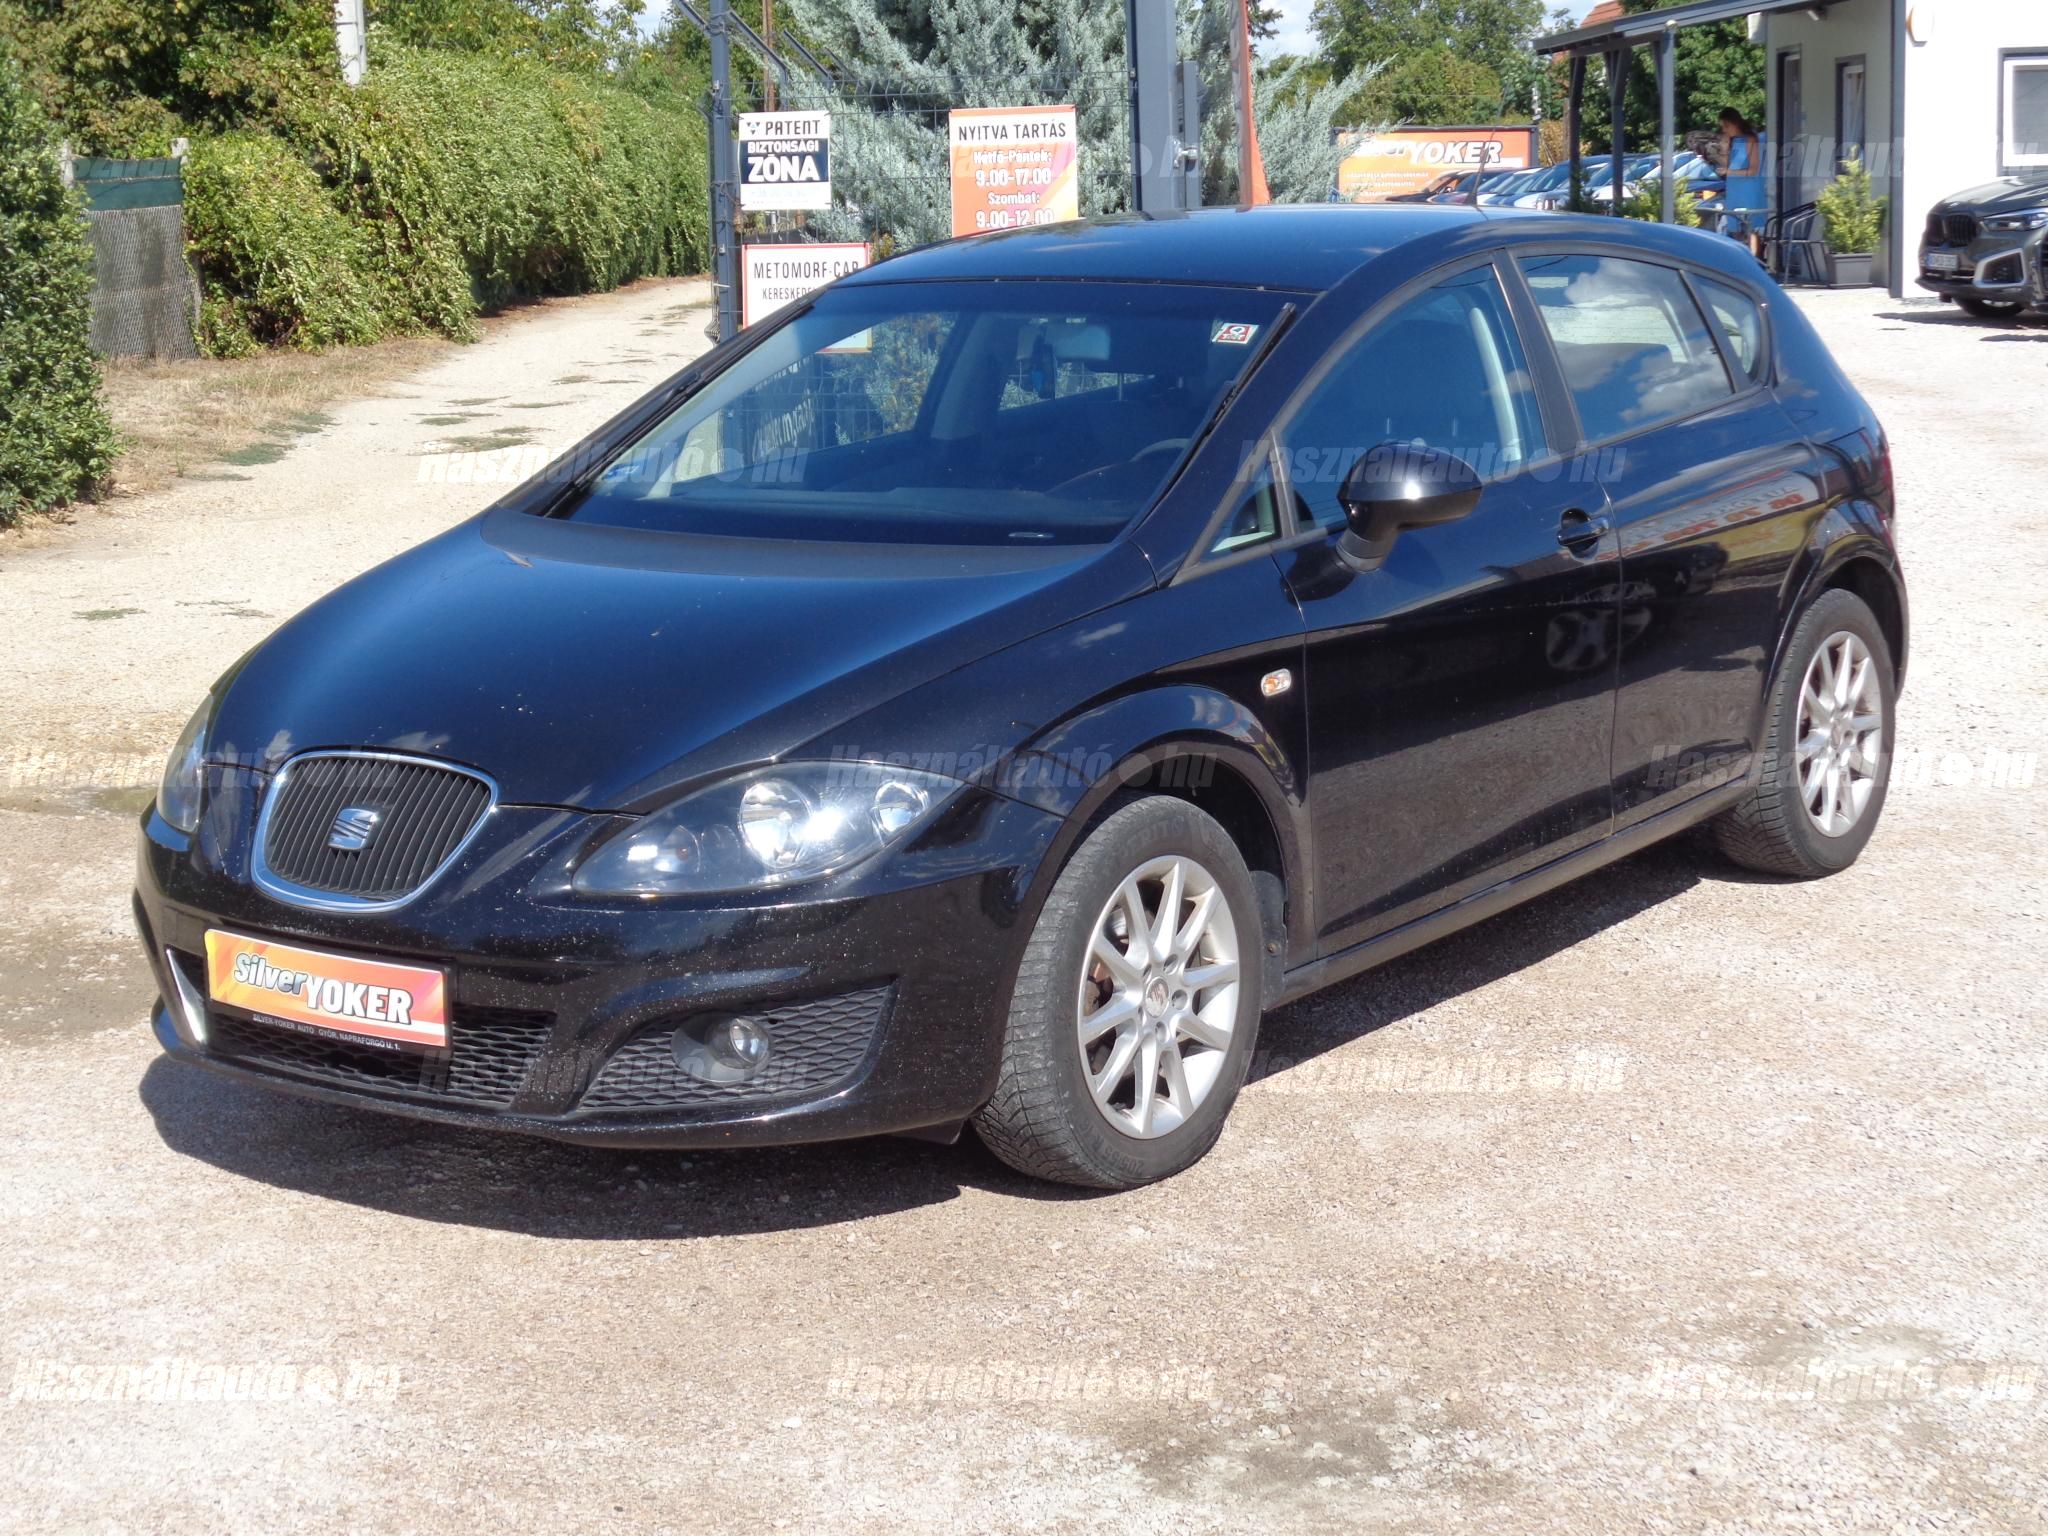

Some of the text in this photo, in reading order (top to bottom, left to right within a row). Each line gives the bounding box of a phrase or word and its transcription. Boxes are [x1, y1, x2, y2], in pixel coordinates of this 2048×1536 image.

[765, 120, 820, 135] PATENT
[959, 119, 1066, 141] NYITVA TARTÁS
[747, 139, 819, 154] BIZTONSÁGI
[747, 153, 820, 183] ZÓNA
[975, 168, 1052, 187] 9.00-17.00
[987, 191, 1040, 205] Szombat:
[975, 208, 1055, 229] 9.00-12.00
